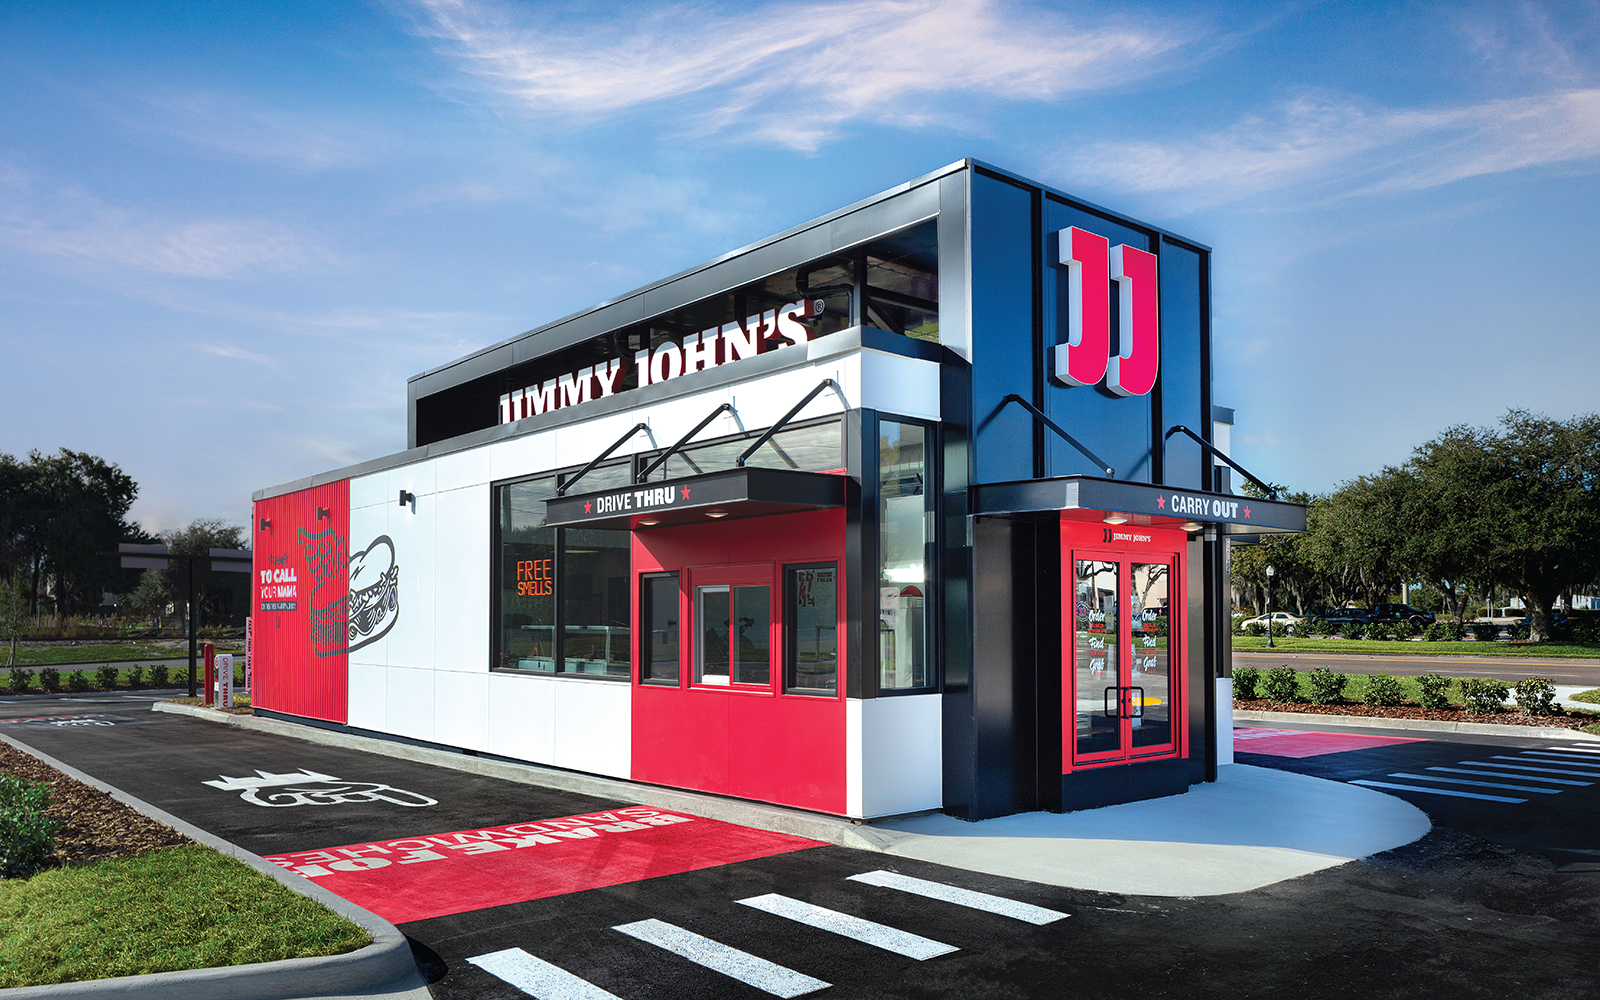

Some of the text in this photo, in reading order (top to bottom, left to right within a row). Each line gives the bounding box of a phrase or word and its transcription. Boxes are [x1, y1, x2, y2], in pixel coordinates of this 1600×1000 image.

[1055, 226, 1158, 397] JJ
[500, 299, 809, 425] JIMMY JOHN'S
[596, 486, 675, 514] DRIVE THRU
[1171, 495, 1239, 519] CARRY OUT
[1113, 532, 1132, 541] JIMMY
[260, 567, 298, 584] TO CALL
[517, 559, 552, 581] FREE
[260, 584, 298, 599] YOUR MAMA
[517, 581, 553, 596] SMELLS
[264, 808, 660, 868] SANDWICHES
[448, 814, 695, 856] BRAKE
